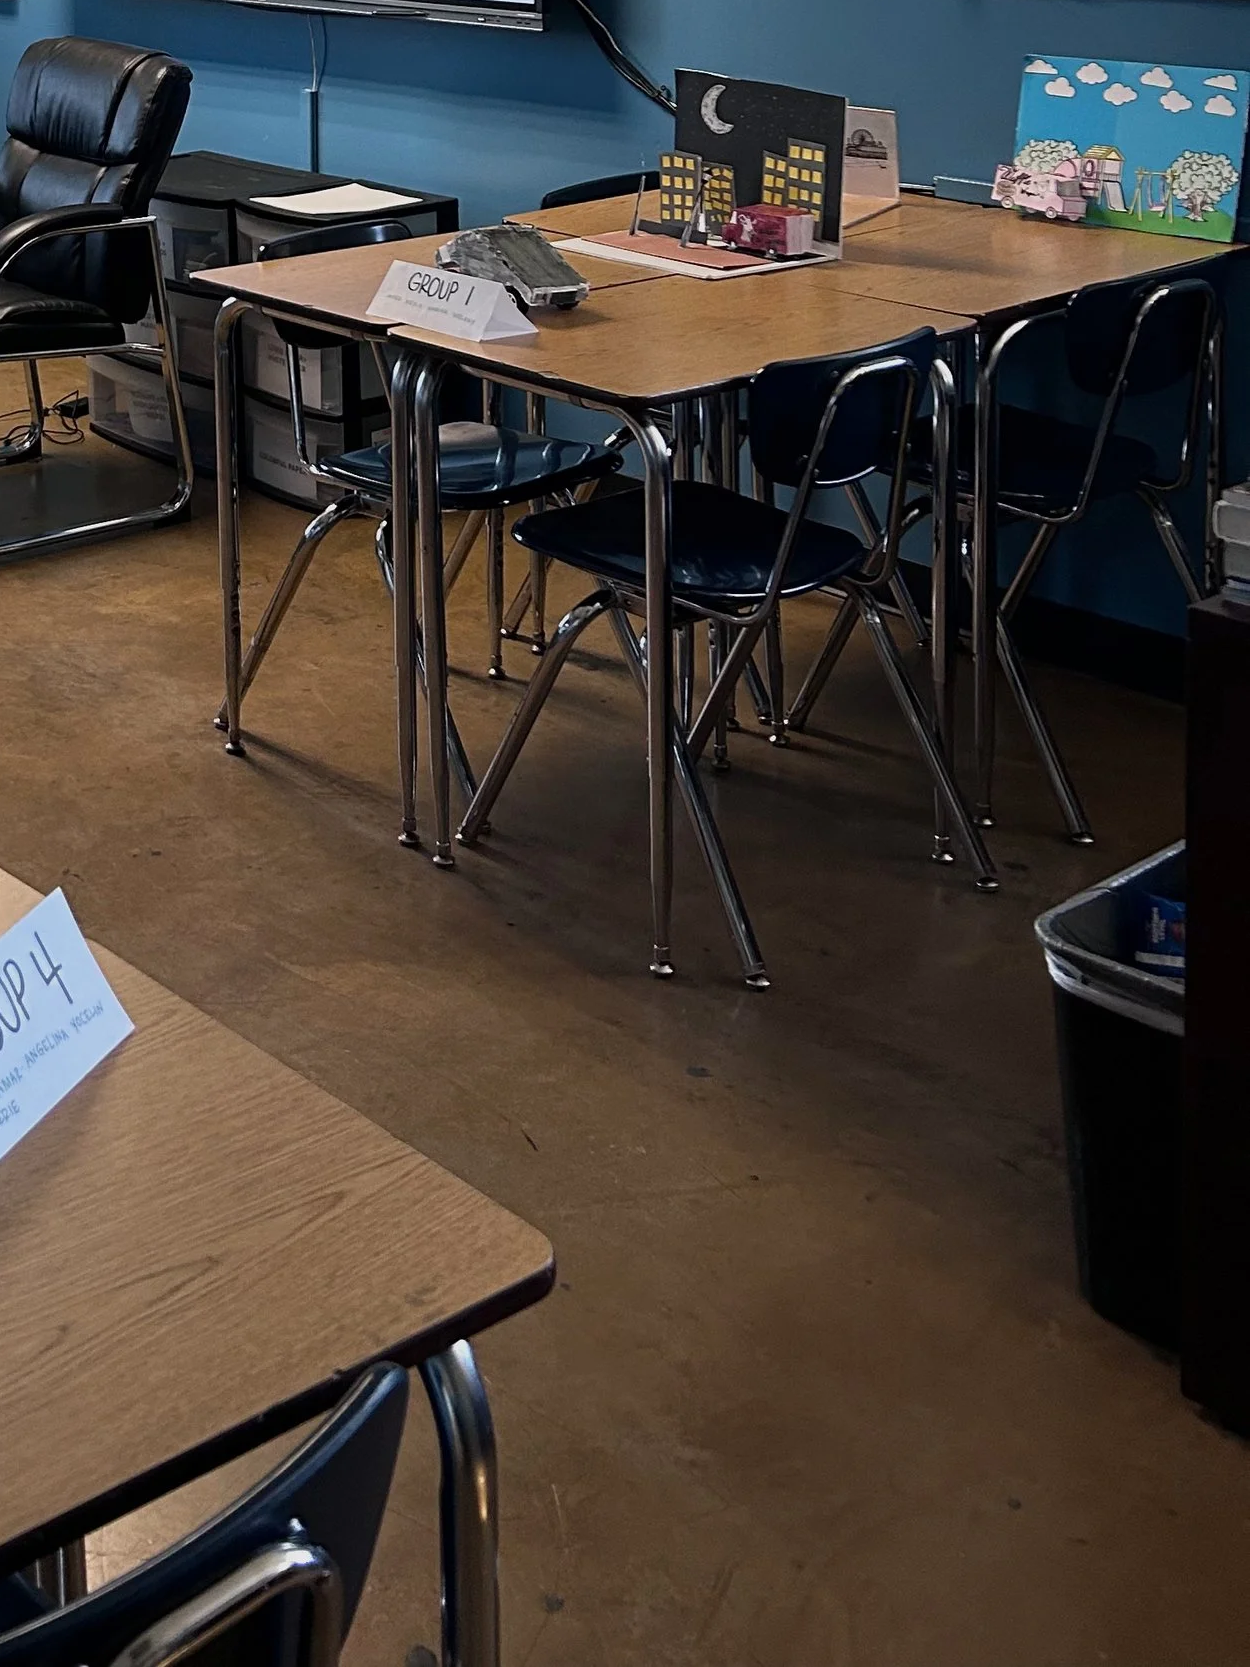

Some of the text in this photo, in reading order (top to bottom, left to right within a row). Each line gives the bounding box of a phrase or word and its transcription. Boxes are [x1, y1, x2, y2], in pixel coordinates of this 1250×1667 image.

[407, 271, 476, 306] GROUP 1
[30, 930, 74, 1005] 4
[24, 1028, 70, 1067] ANGELINA
